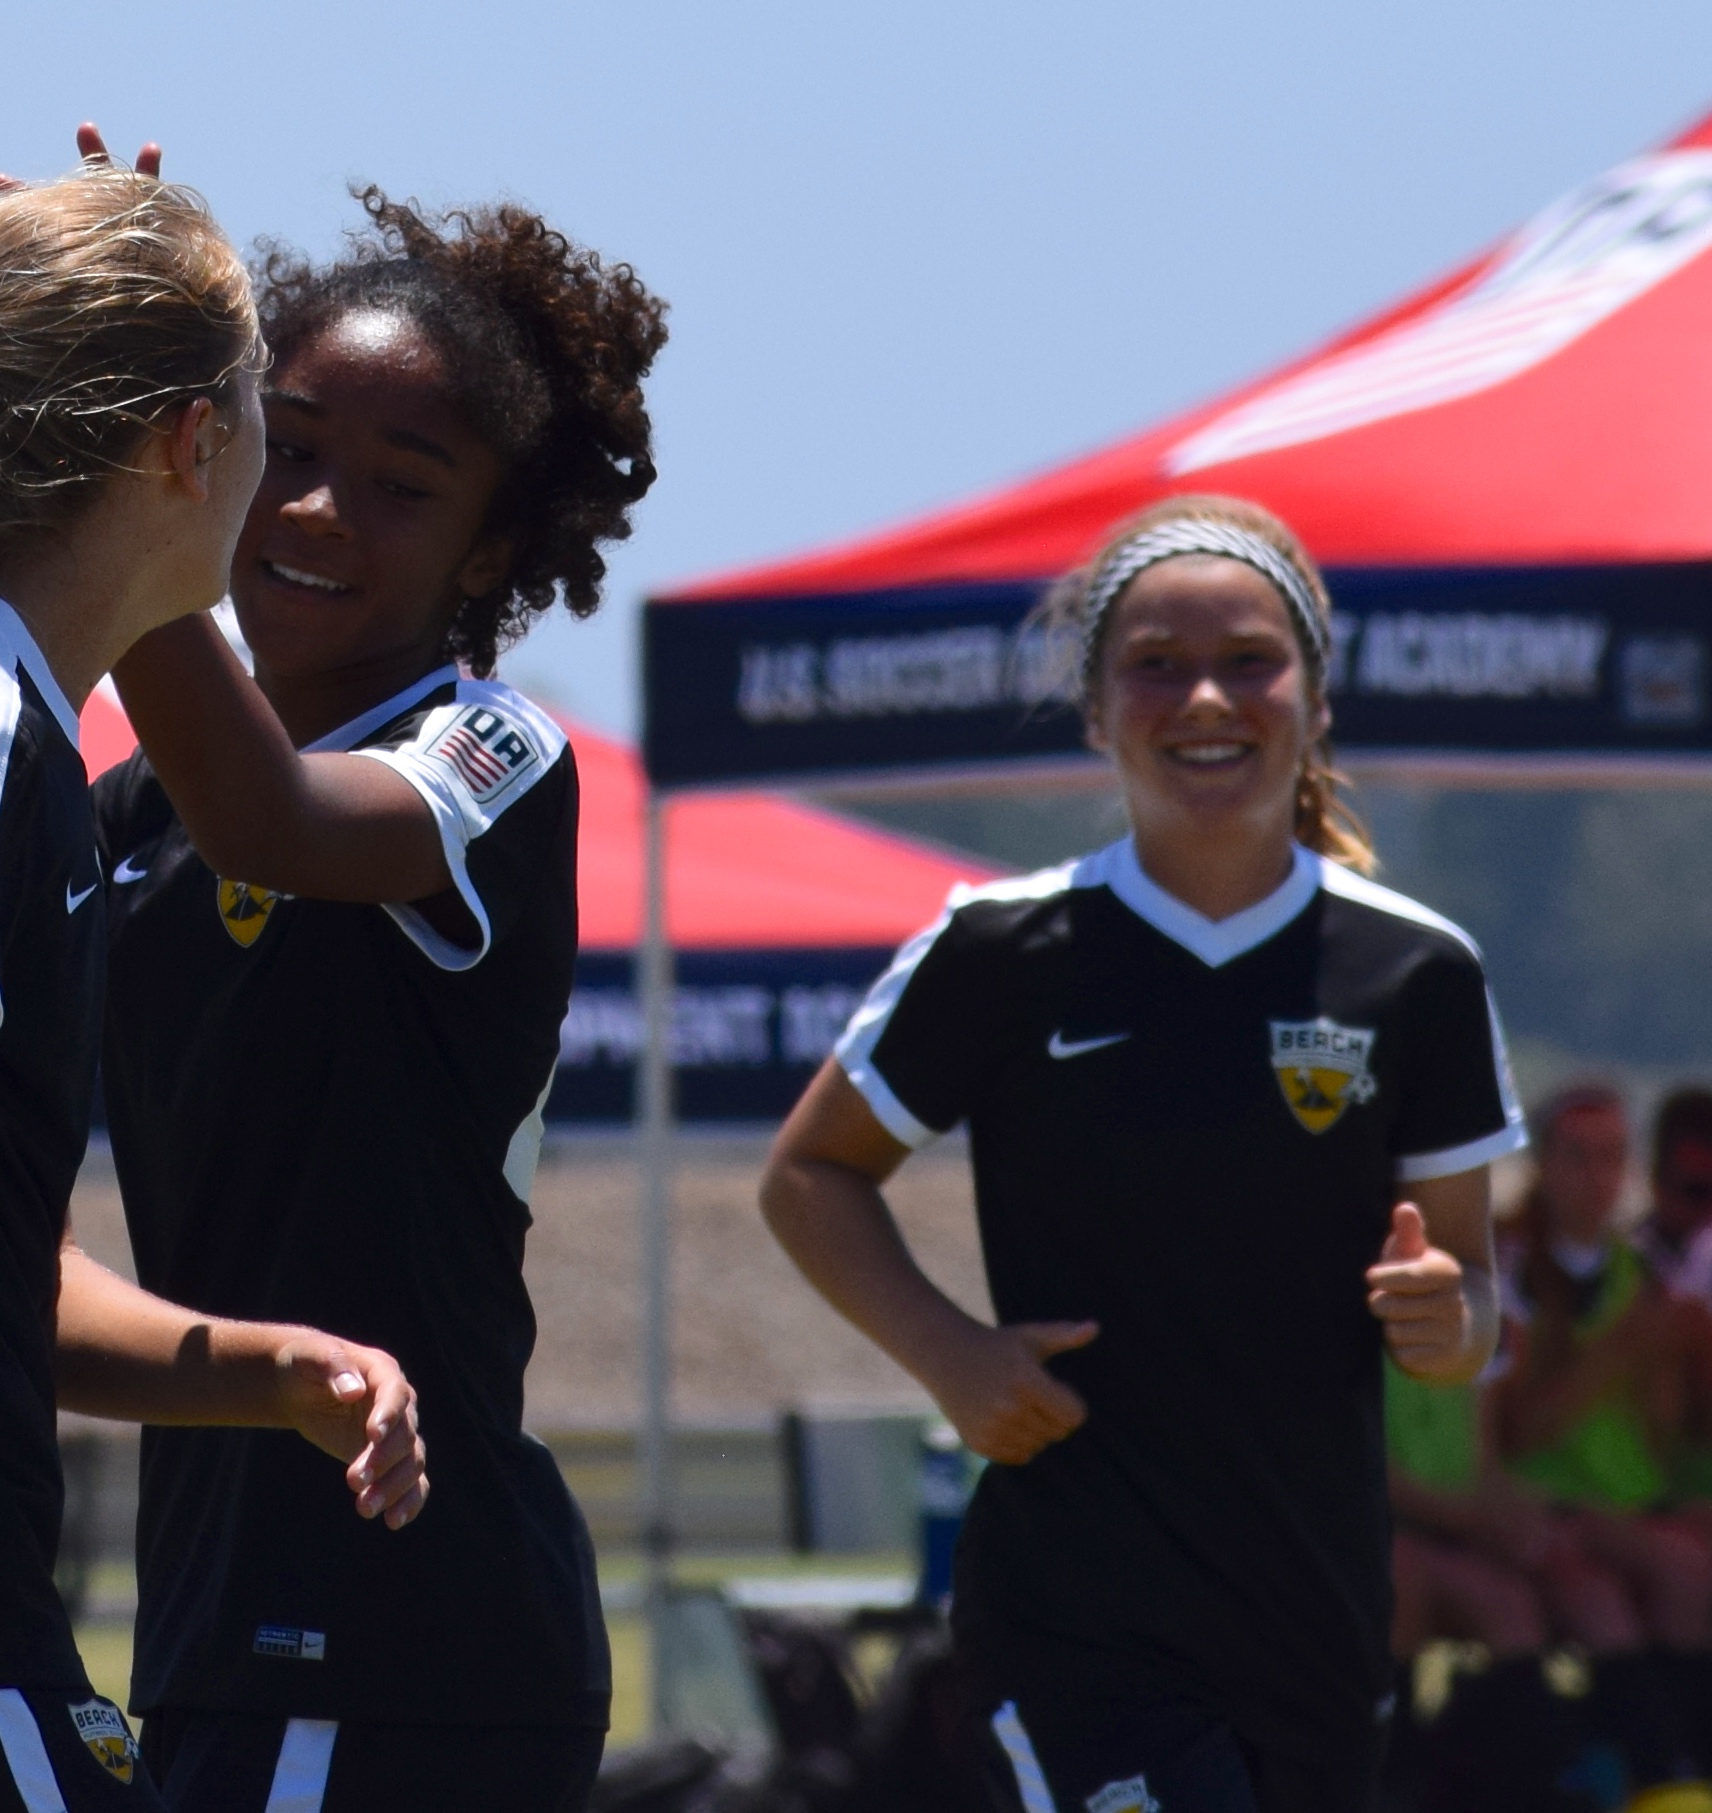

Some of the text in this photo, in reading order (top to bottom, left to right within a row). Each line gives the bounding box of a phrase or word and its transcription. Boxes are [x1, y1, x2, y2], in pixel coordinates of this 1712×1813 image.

[462, 708, 531, 769] DA
[1280, 1030, 1363, 1052] BEACH
[75, 1709, 120, 1728] BEACH
